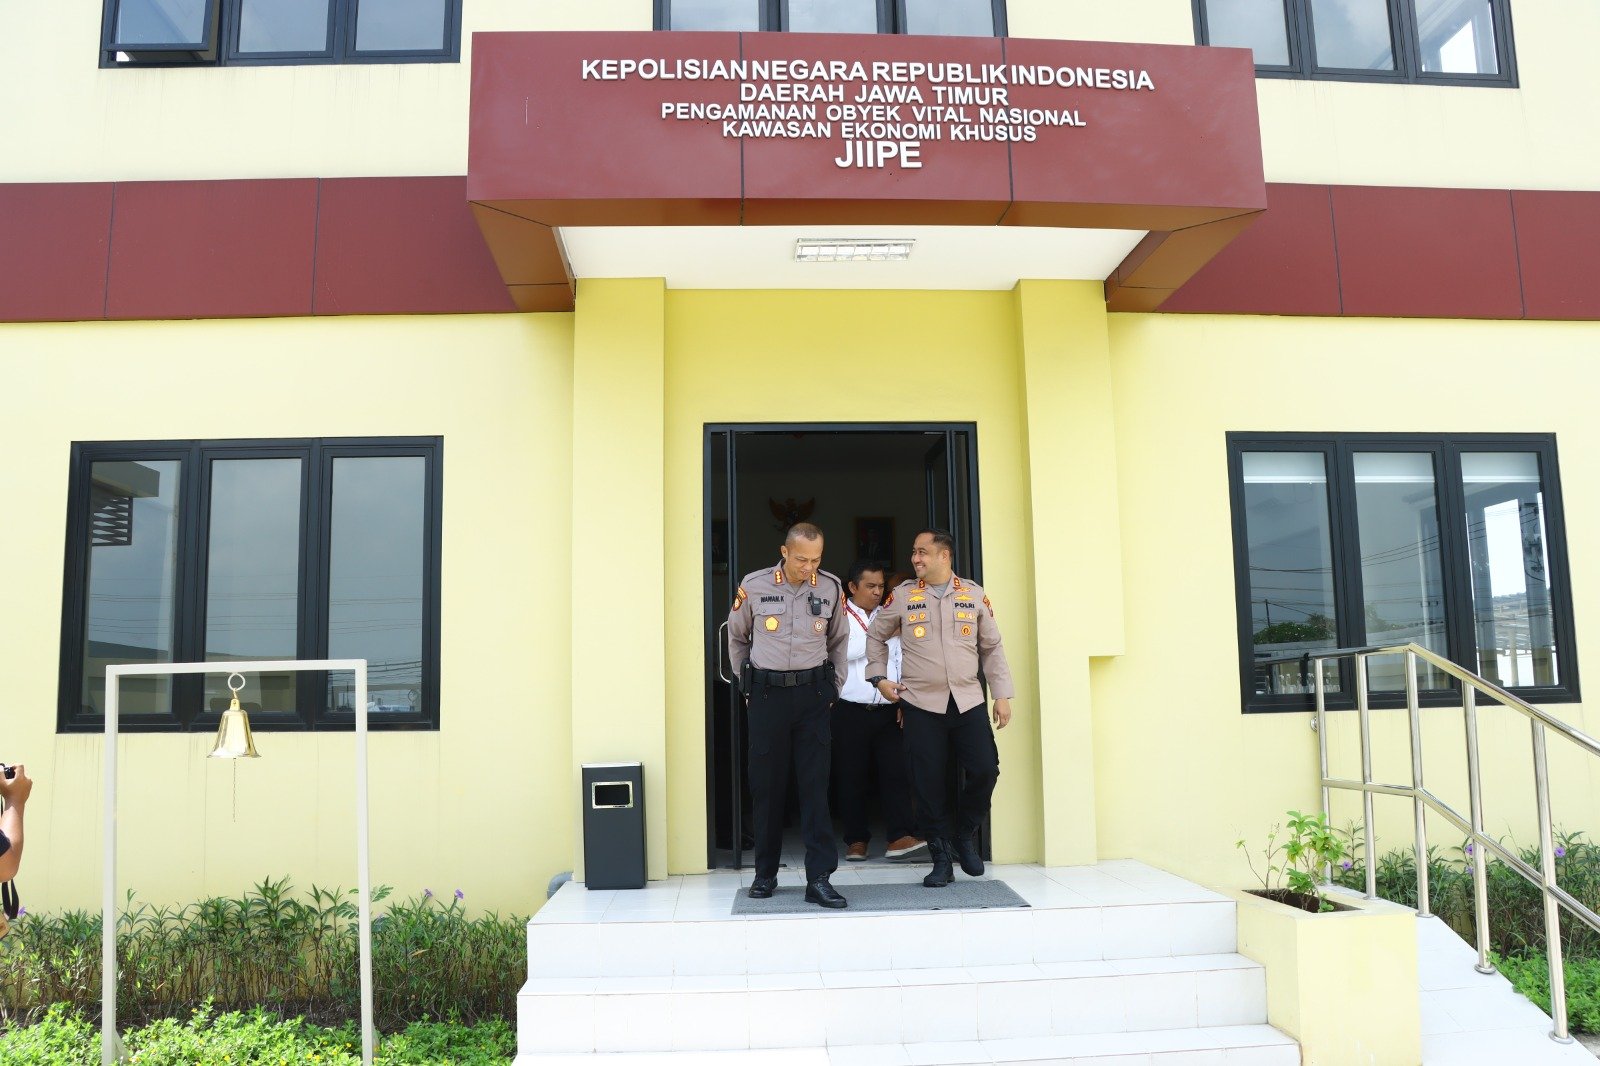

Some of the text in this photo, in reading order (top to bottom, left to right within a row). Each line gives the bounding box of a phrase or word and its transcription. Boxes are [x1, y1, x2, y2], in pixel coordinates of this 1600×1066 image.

[583, 59, 1155, 90] KEPOLISIAN NEGARA REPUBLIK INDONESIA
[740, 83, 1009, 105] DAERAH JAWA TIMUR
[661, 103, 1087, 126] PENGAMANAN OBYEK VITAL NASIONAL
[723, 121, 1037, 141] KAWASAN EKONOMI KHUSUS
[835, 140, 922, 167] JIIPE
[907, 603, 927, 611] RAMA
